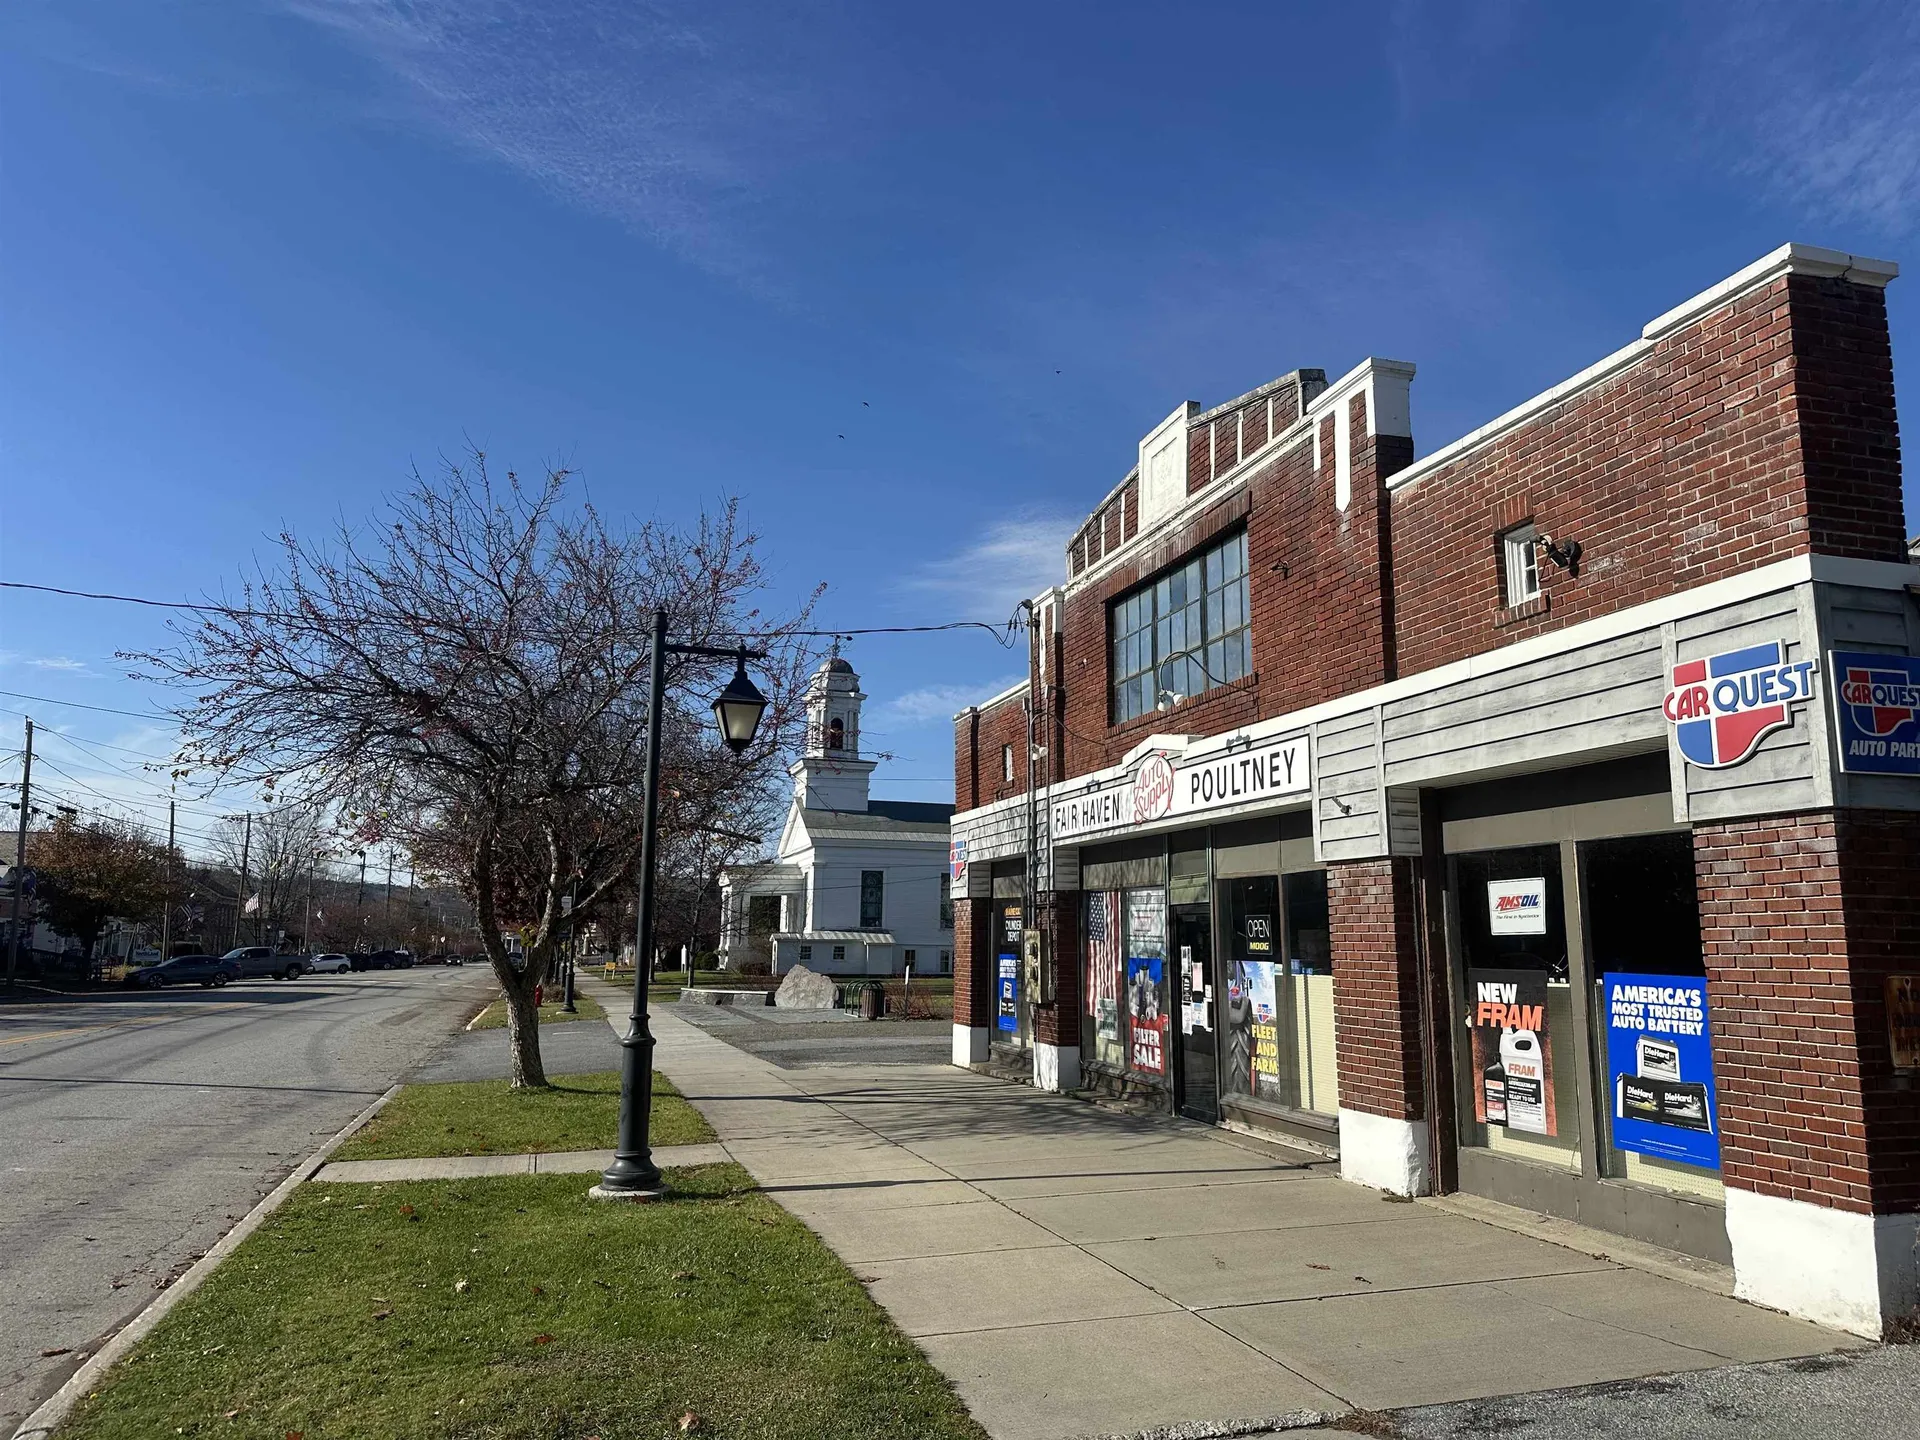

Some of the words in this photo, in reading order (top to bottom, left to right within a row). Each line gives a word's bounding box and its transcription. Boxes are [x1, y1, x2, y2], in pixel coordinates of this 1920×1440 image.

[1663, 661, 1813, 721] CARQUEST
[1849, 740, 1887, 757] AUTO
[1191, 748, 1296, 804] POULTNEY
[1055, 804, 1078, 833] FAIR
[1082, 793, 1120, 827] HAVEN
[1495, 895, 1539, 911] AMSOIL
[1247, 920, 1270, 938] OPEN
[1249, 942, 1270, 951] MOOG
[1477, 982, 1518, 1004] NEW
[1612, 985, 1702, 1007] AMERICA'S
[1477, 1002, 1543, 1032] FRAM
[1612, 1002, 1645, 1016] MOST
[1648, 1005, 1704, 1022] TRUSTED
[1251, 1024, 1277, 1041] FLEET
[1612, 1015, 1646, 1030] AUTO
[1648, 1018, 1704, 1036] BATTERY
[1133, 1027, 1160, 1047] FILTER
[1133, 1044, 1161, 1070] SALE
[1256, 1041, 1277, 1057] AND
[1644, 1046, 1670, 1060] DieHard
[1251, 1056, 1278, 1075] FARM
[1508, 1063, 1535, 1077] FRAM
[1627, 1085, 1654, 1099] DieHard
[1664, 1092, 1693, 1104] DieHard
